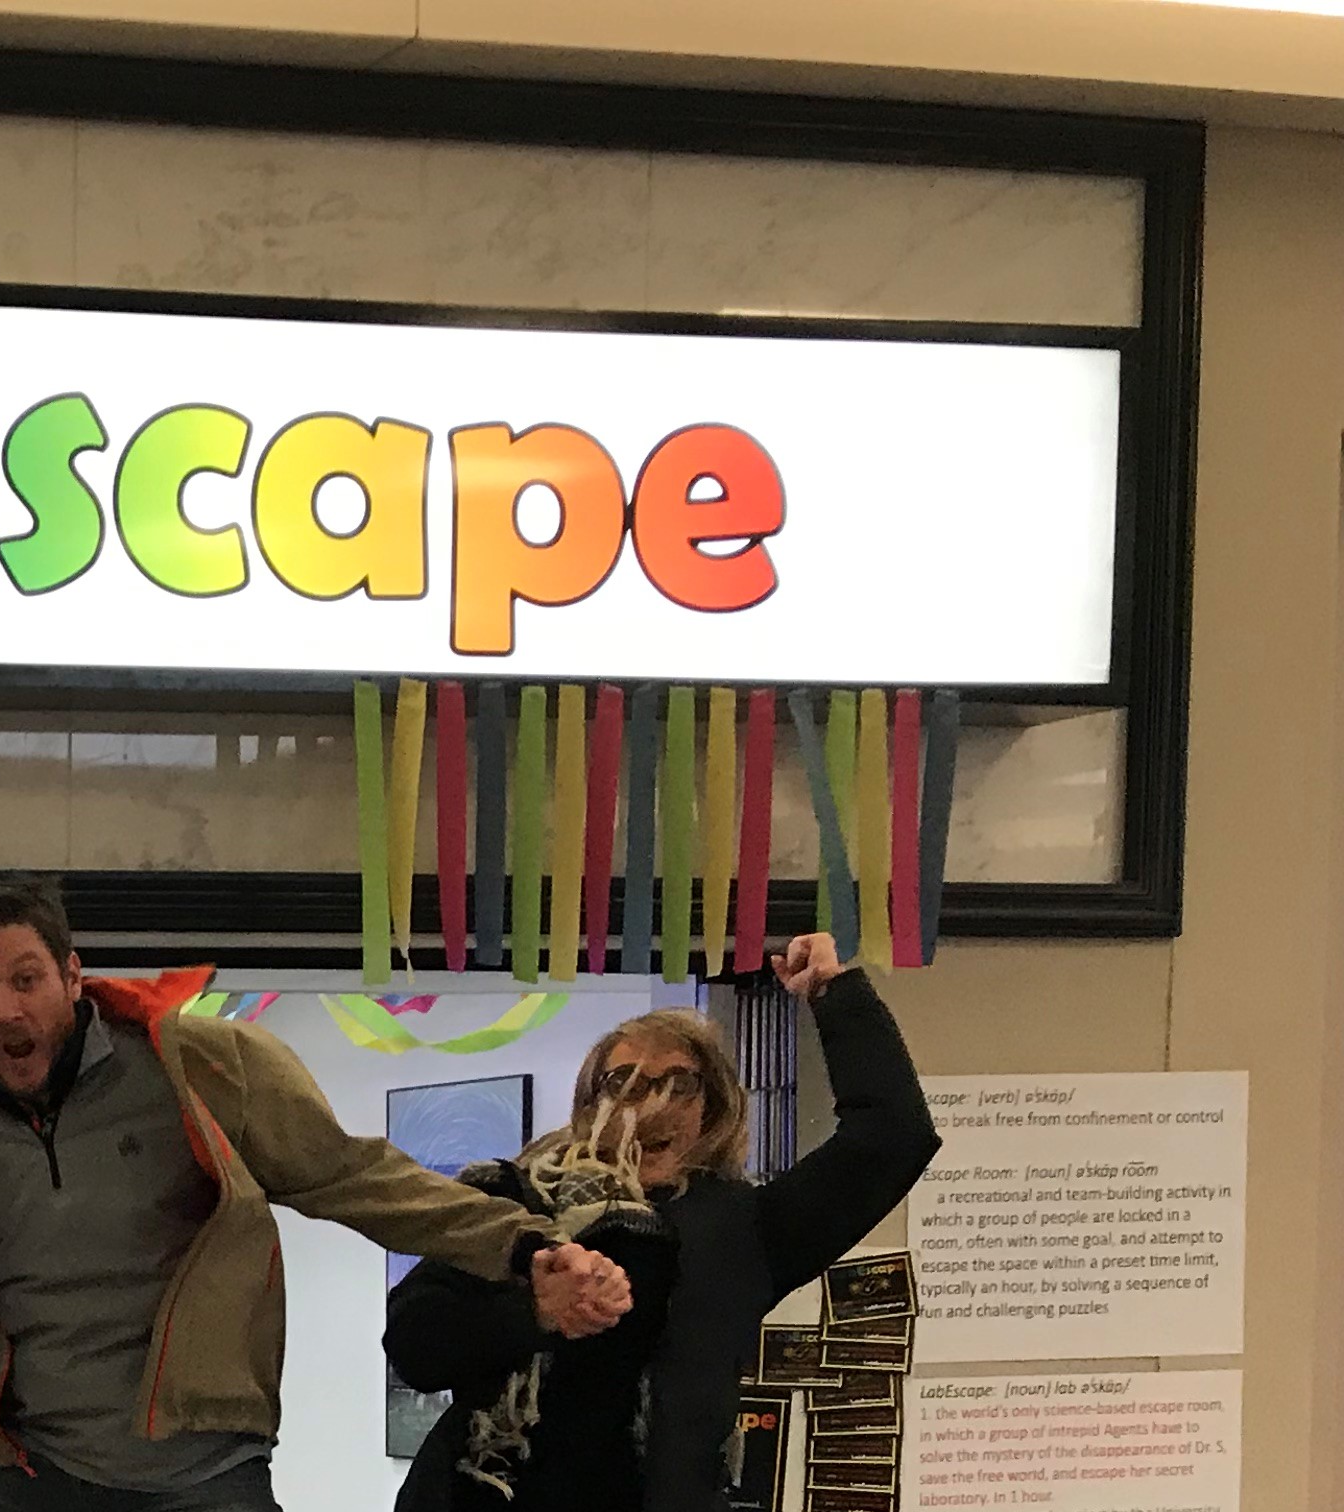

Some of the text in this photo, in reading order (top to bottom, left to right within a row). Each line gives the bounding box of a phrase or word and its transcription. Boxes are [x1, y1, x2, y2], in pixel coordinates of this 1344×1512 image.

[924, 1092, 970, 1110] scape:
[952, 1114, 990, 1127] break
[995, 1111, 1023, 1127] free
[1026, 1110, 1061, 1126] from
[1064, 1110, 1153, 1125] confinement
[1175, 1110, 1223, 1124] control
[948, 1190, 1033, 1204] recreational
[1035, 1186, 1062, 1202] and
[1065, 1185, 1163, 1203] team-building
[1165, 1185, 1216, 1200] activity
[920, 1212, 962, 1227] which
[977, 1213, 1019, 1229] group
[1039, 1210, 1088, 1227] people
[1091, 1211, 1115, 1223] are
[1117, 1207, 1163, 1223] locked
[921, 1237, 962, 1251] room,
[965, 1233, 1003, 1249] often
[1006, 1234, 1038, 1247] with
[1040, 1234, 1079, 1247] some
[1119, 1231, 1146, 1245] and
[1148, 1230, 1205, 1245] attempt
[920, 1260, 968, 1274] escape
[971, 1258, 995, 1272] the
[998, 1258, 1038, 1272] space
[1041, 1255, 1085, 1270] within
[1100, 1255, 1146, 1269] preset
[1148, 1254, 1181, 1267] time
[1183, 1251, 1219, 1267] limit,
[920, 1280, 977, 1298] typically
[1060, 1279, 1110, 1295] solving
[1125, 1277, 1191, 1291] sequence
[919, 1303, 942, 1319] fun
[945, 1302, 972, 1318] and
[975, 1301, 1054, 1320] challenging
[1058, 1302, 1108, 1315] puzzles
